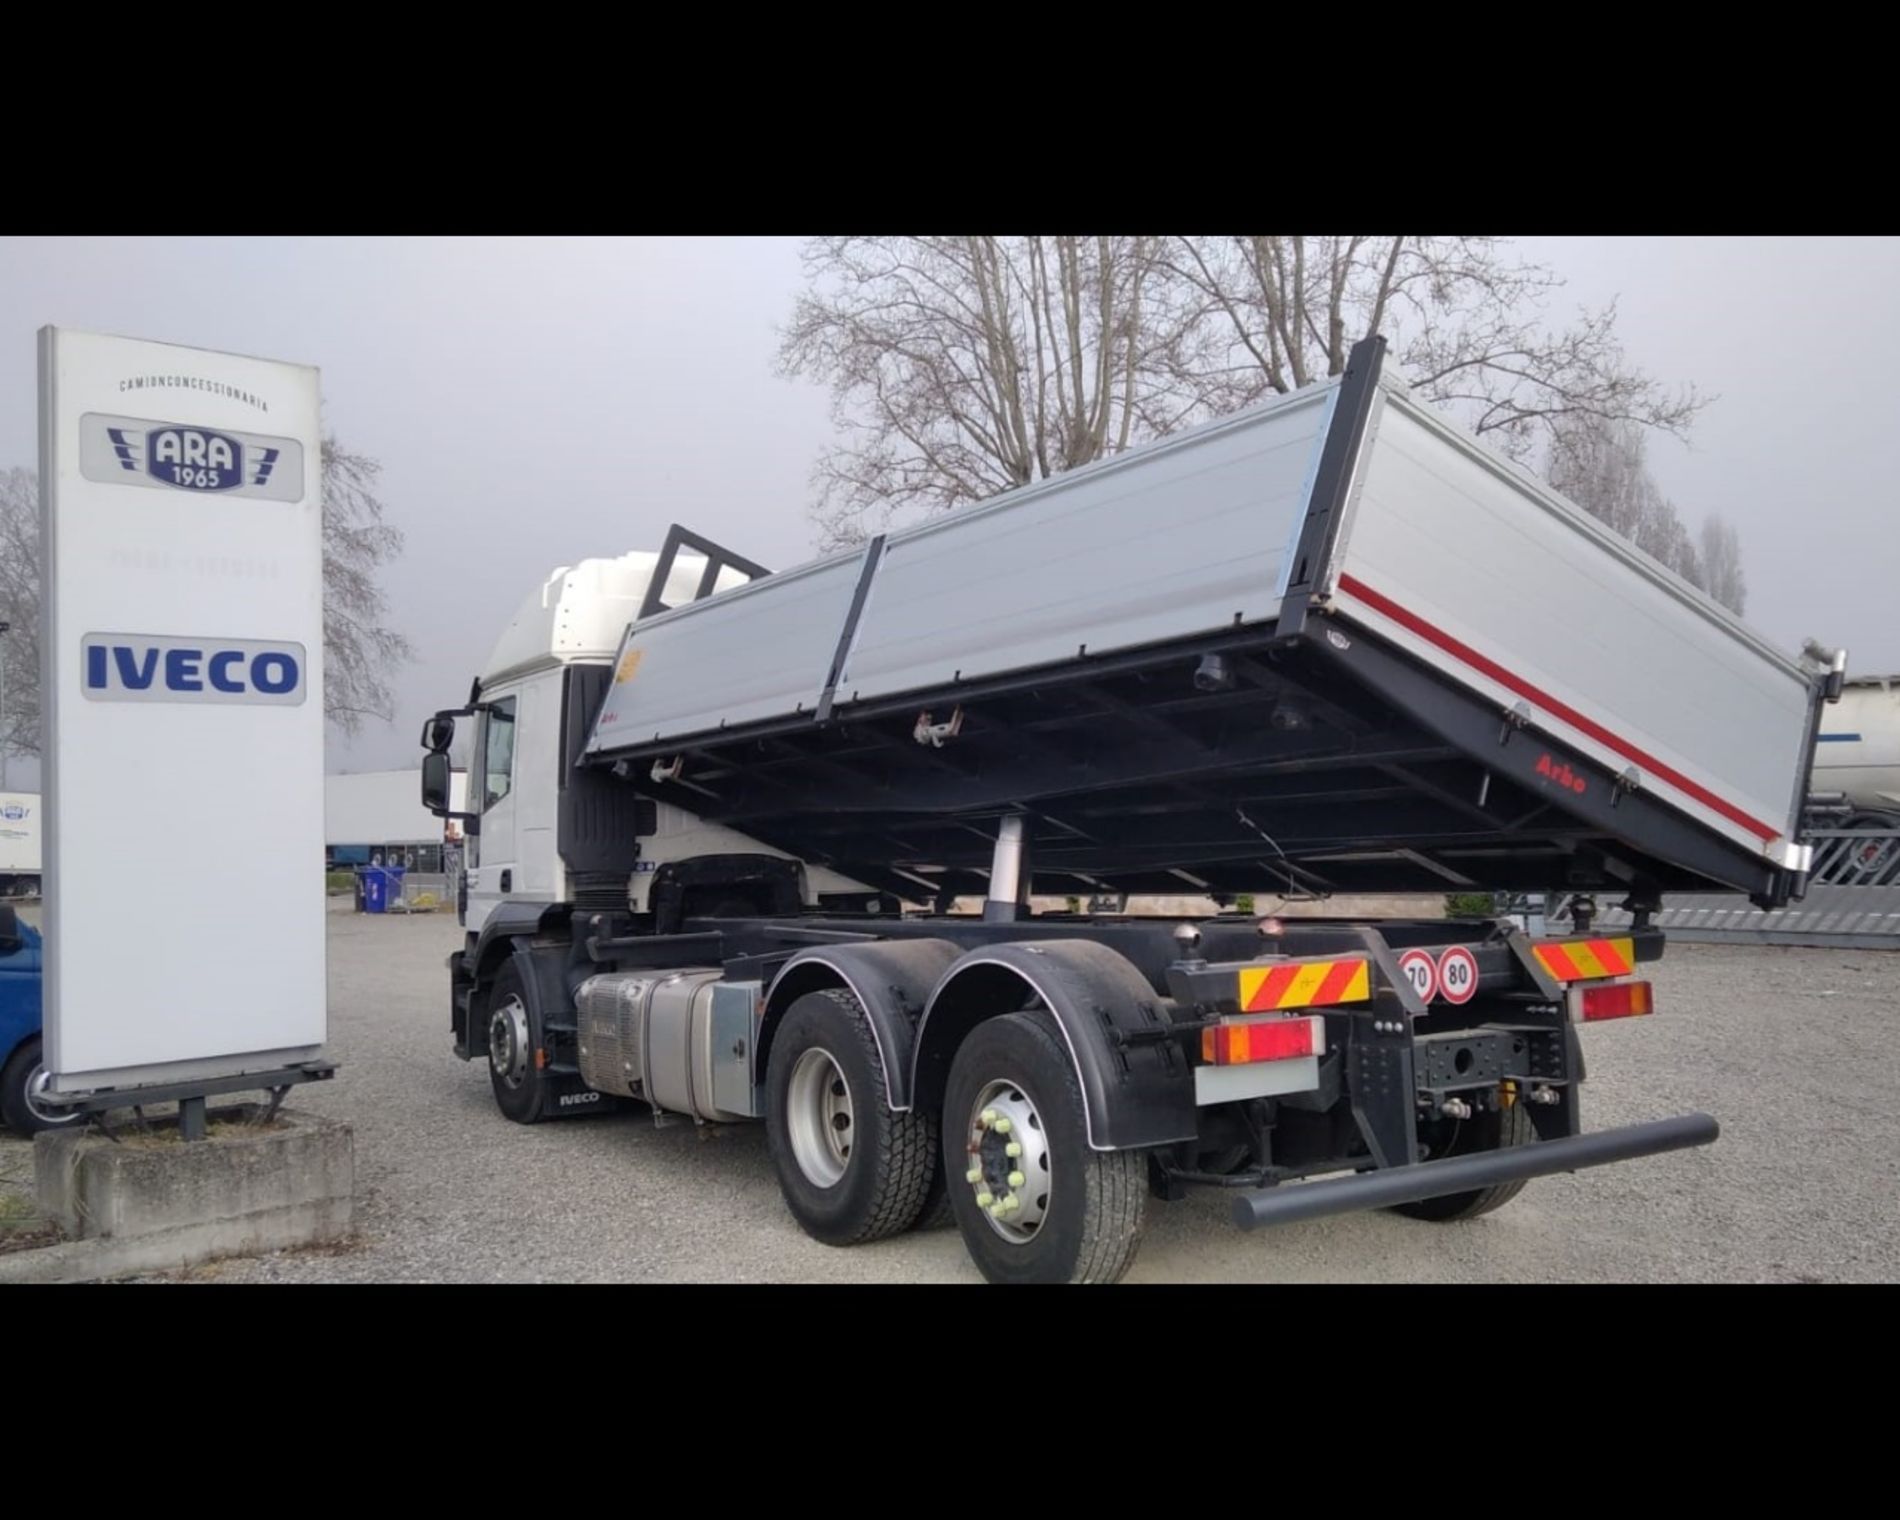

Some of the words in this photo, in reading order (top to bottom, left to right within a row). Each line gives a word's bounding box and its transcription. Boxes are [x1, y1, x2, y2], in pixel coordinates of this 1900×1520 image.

[119, 376, 268, 412] CAMIONCONCESSIONARIA
[156, 431, 233, 470] ARA
[173, 467, 219, 487] 1965
[88, 645, 298, 694] IVECO
[1535, 752, 1586, 794] Arbo
[1408, 966, 1427, 987] 70
[1449, 963, 1467, 985] 80
[560, 1092, 600, 1106] IVECO
